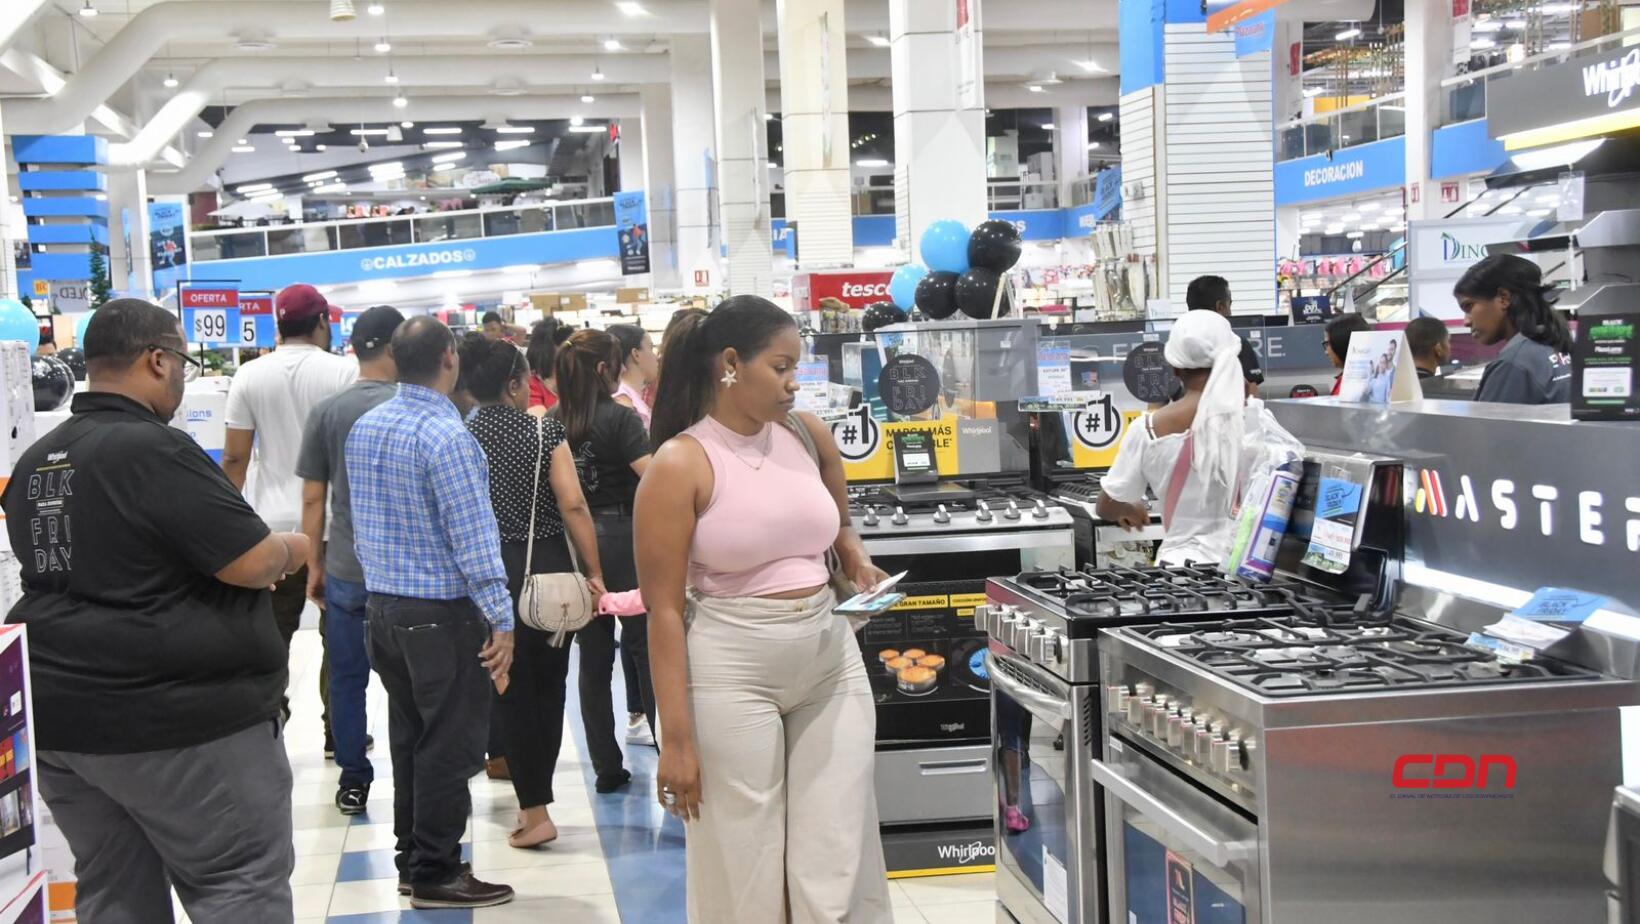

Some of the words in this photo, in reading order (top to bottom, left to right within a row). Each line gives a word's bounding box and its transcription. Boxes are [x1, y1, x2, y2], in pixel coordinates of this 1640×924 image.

[1304, 160, 1364, 187] DECORACION
[373, 250, 463, 270] CALZADOS
[190, 293, 227, 304] OFERTA
[195, 314, 225, 338] $99
[27, 469, 76, 500] BLK
[30, 515, 72, 546] FRI
[34, 546, 72, 573] DAY
[938, 841, 995, 863] Whirlpoo
